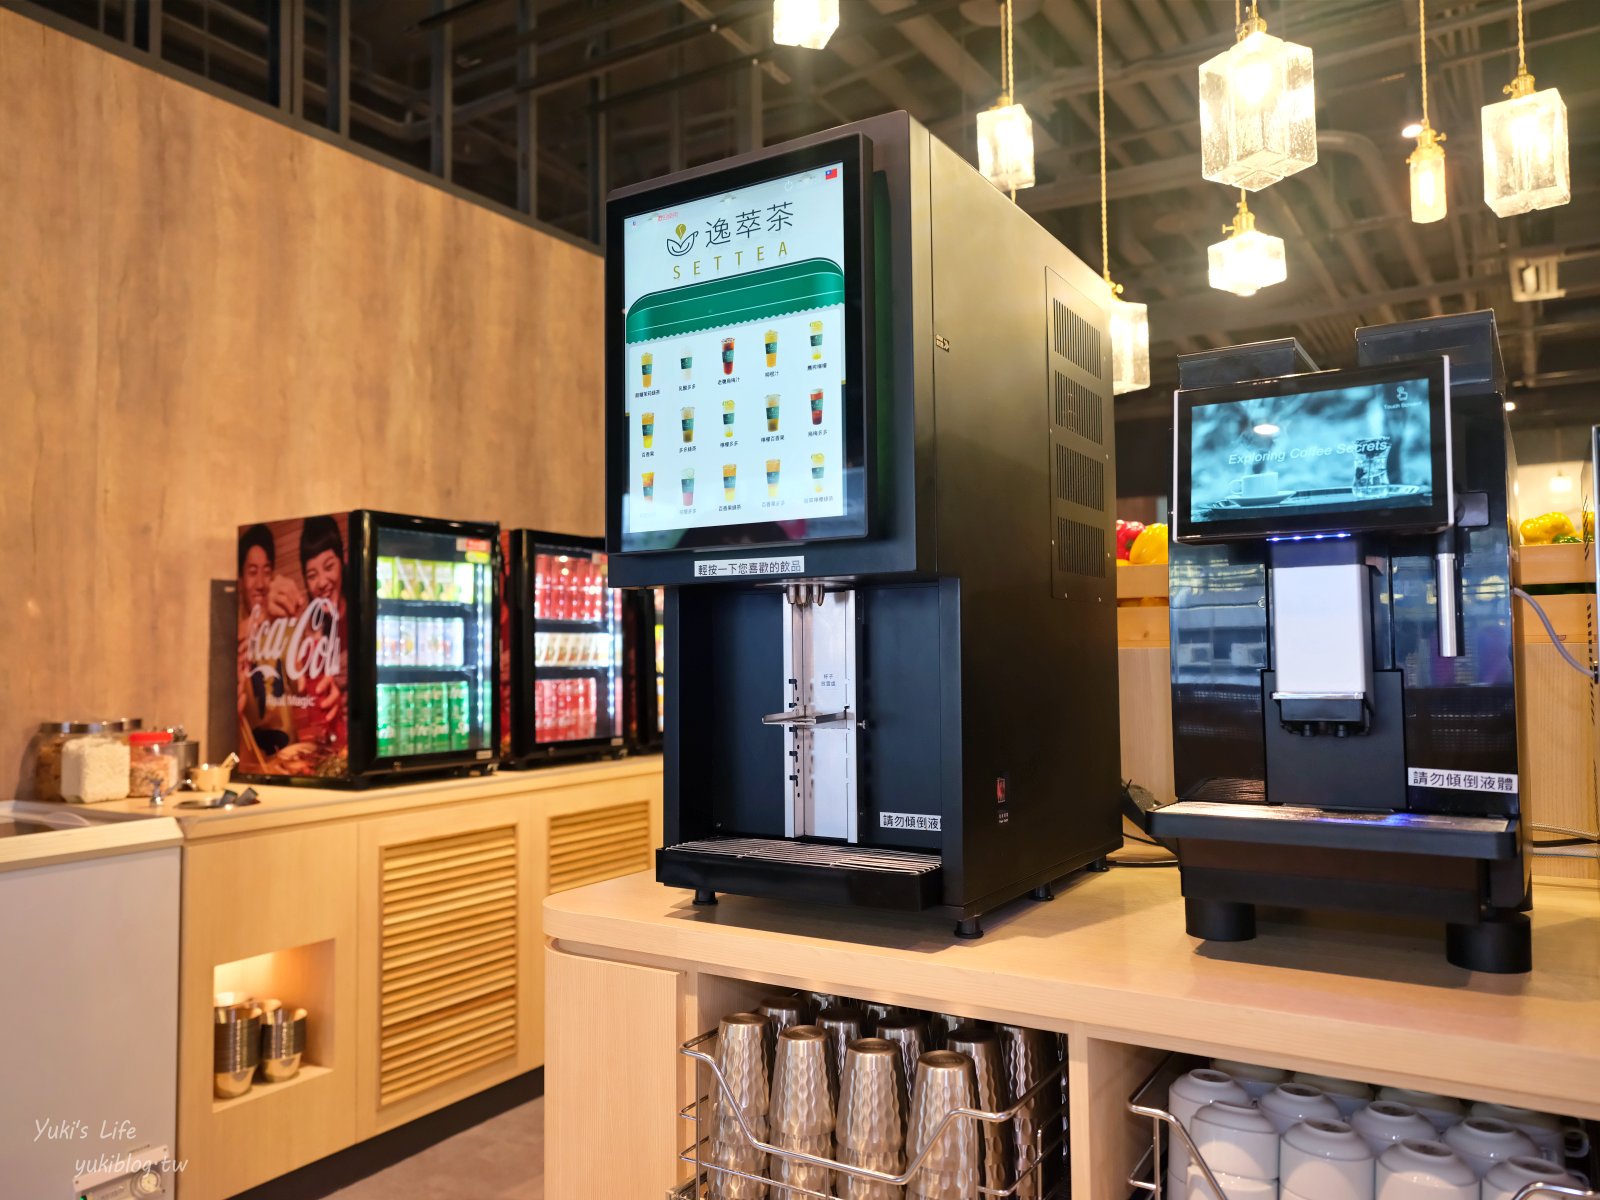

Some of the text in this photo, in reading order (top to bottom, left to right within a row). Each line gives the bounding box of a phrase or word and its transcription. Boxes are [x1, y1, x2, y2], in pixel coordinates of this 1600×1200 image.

[705, 201, 794, 248] 逸萃茶
[673, 241, 788, 280] SETTEA
[1228, 439, 1389, 466] Exploring Coffee Secrets
[698, 559, 802, 576] 輕按一下您喜歡的飲品
[1413, 770, 1514, 792] 請勿傾倒液體
[883, 812, 942, 832] 請勿傾倒液
